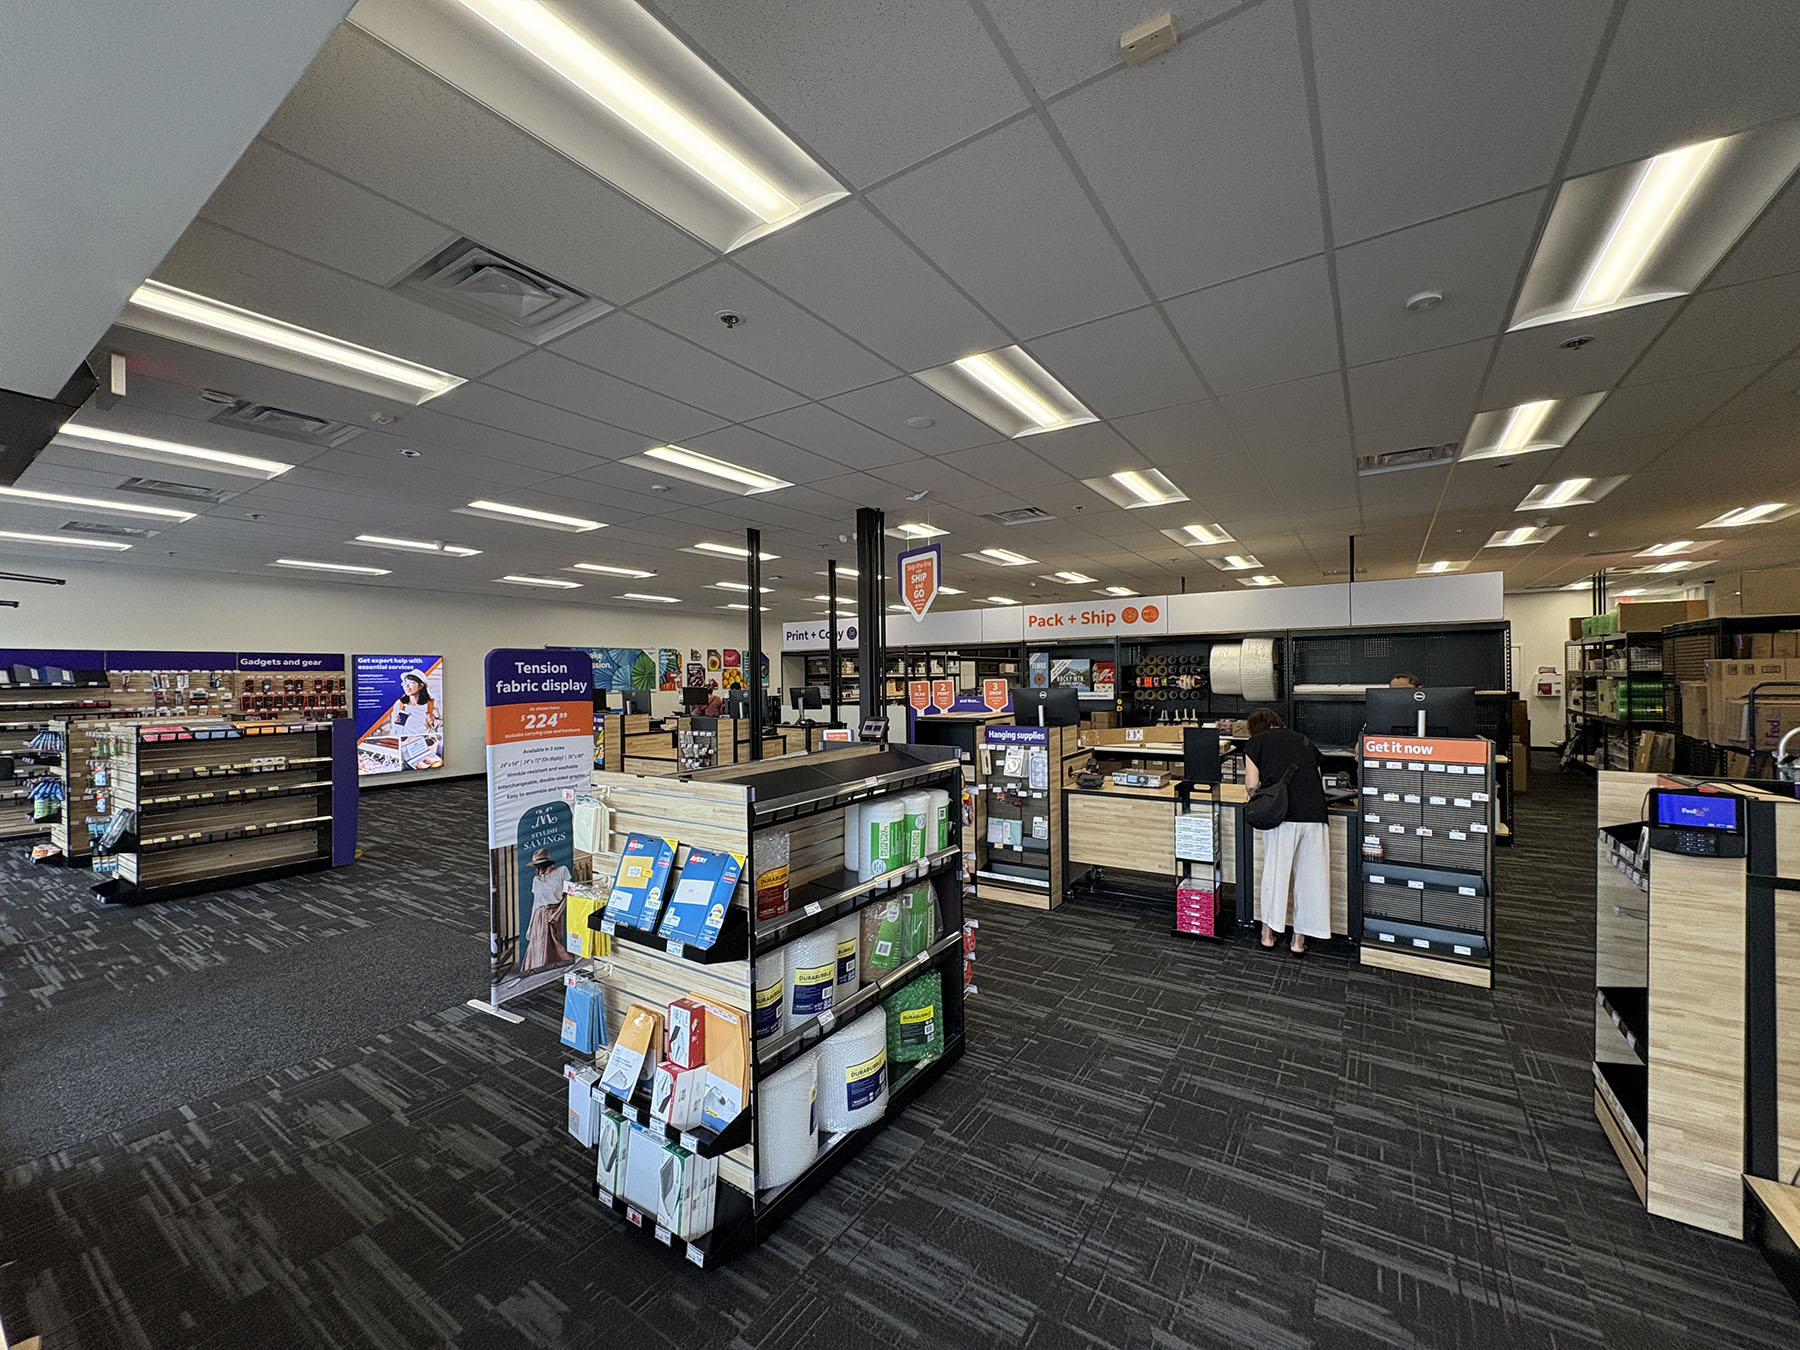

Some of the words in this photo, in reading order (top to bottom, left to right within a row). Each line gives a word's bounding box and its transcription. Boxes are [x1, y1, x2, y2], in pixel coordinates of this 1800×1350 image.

[911, 573, 927, 583] SHIP
[914, 589, 925, 598] GO
[1028, 613, 1064, 627] Pack
[1081, 610, 1116, 627] Ship
[786, 630, 808, 640] Print
[819, 629, 844, 641] Coy
[240, 658, 281, 667] Gadgets
[515, 661, 568, 674] Tension
[496, 679, 538, 694] fabric
[541, 679, 587, 694] display
[917, 684, 921, 692] 1
[988, 730, 1016, 740] Hanging
[1017, 731, 1045, 741] supplies
[1365, 741, 1389, 753] Get
[1391, 741, 1402, 753] it
[1404, 745, 1433, 755] now
[507, 767, 548, 778] Wrinkle-resistant
[531, 827, 558, 839] STYLISH
[523, 832, 566, 850] SAVINGS
[628, 842, 644, 850] AVERY
[690, 856, 708, 864] AVERY
[838, 946, 854, 954] BUBBLE
[799, 971, 832, 981] DURABUBBLE
[902, 1010, 931, 1020] DURABUBBLE
[850, 1058, 882, 1078] DURABUBBLE
